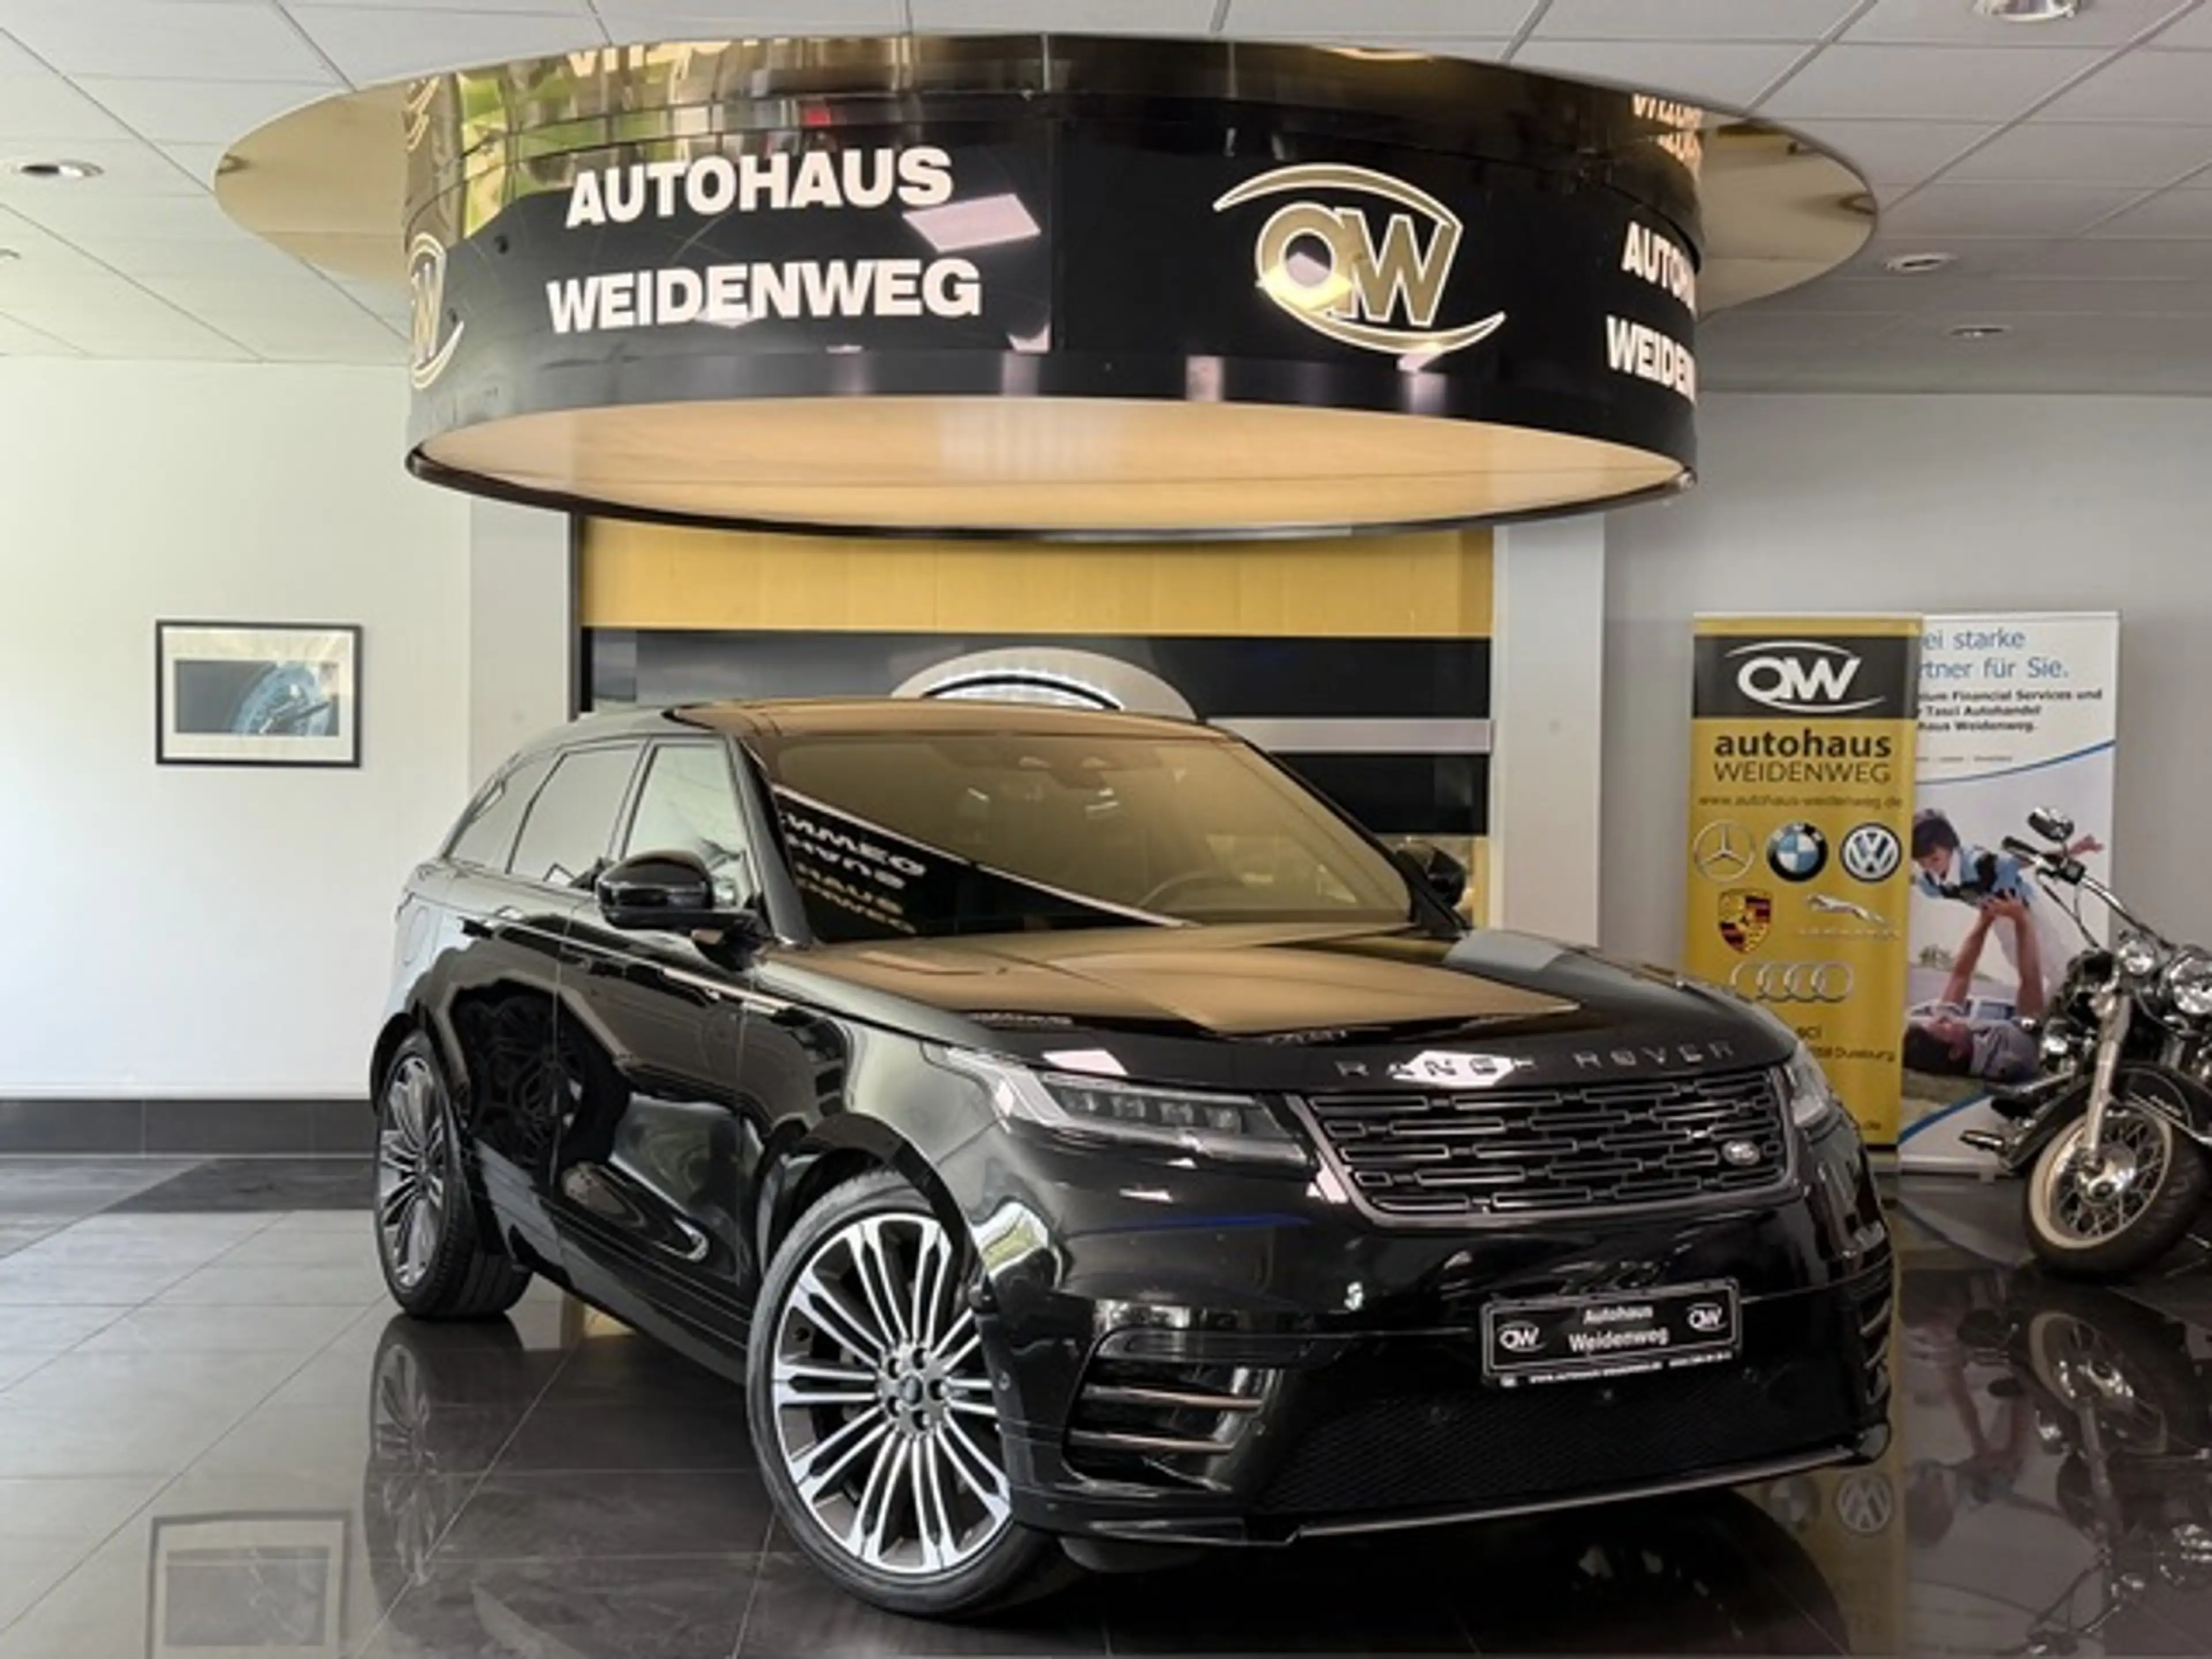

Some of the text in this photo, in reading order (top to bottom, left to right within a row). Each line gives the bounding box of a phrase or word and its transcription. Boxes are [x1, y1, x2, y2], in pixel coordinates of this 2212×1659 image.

[566, 146, 953, 229] AUTOHAUS
[546, 257, 982, 334] WEIDENWEG
[1919, 628, 2026, 650] ei starke
[1983, 657, 2017, 679] für
[2027, 656, 2069, 679] Sie.
[2016, 689, 2071, 700] Services
[2077, 688, 2103, 700] und
[1715, 727, 1891, 757] autohaus
[1714, 760, 1891, 783] WEIDENWEG
[1334, 1040, 1733, 1078] RANGE ROVER
[1583, 1304, 1654, 1325] Autohaus
[1567, 1326, 1669, 1353] Weidenweg
